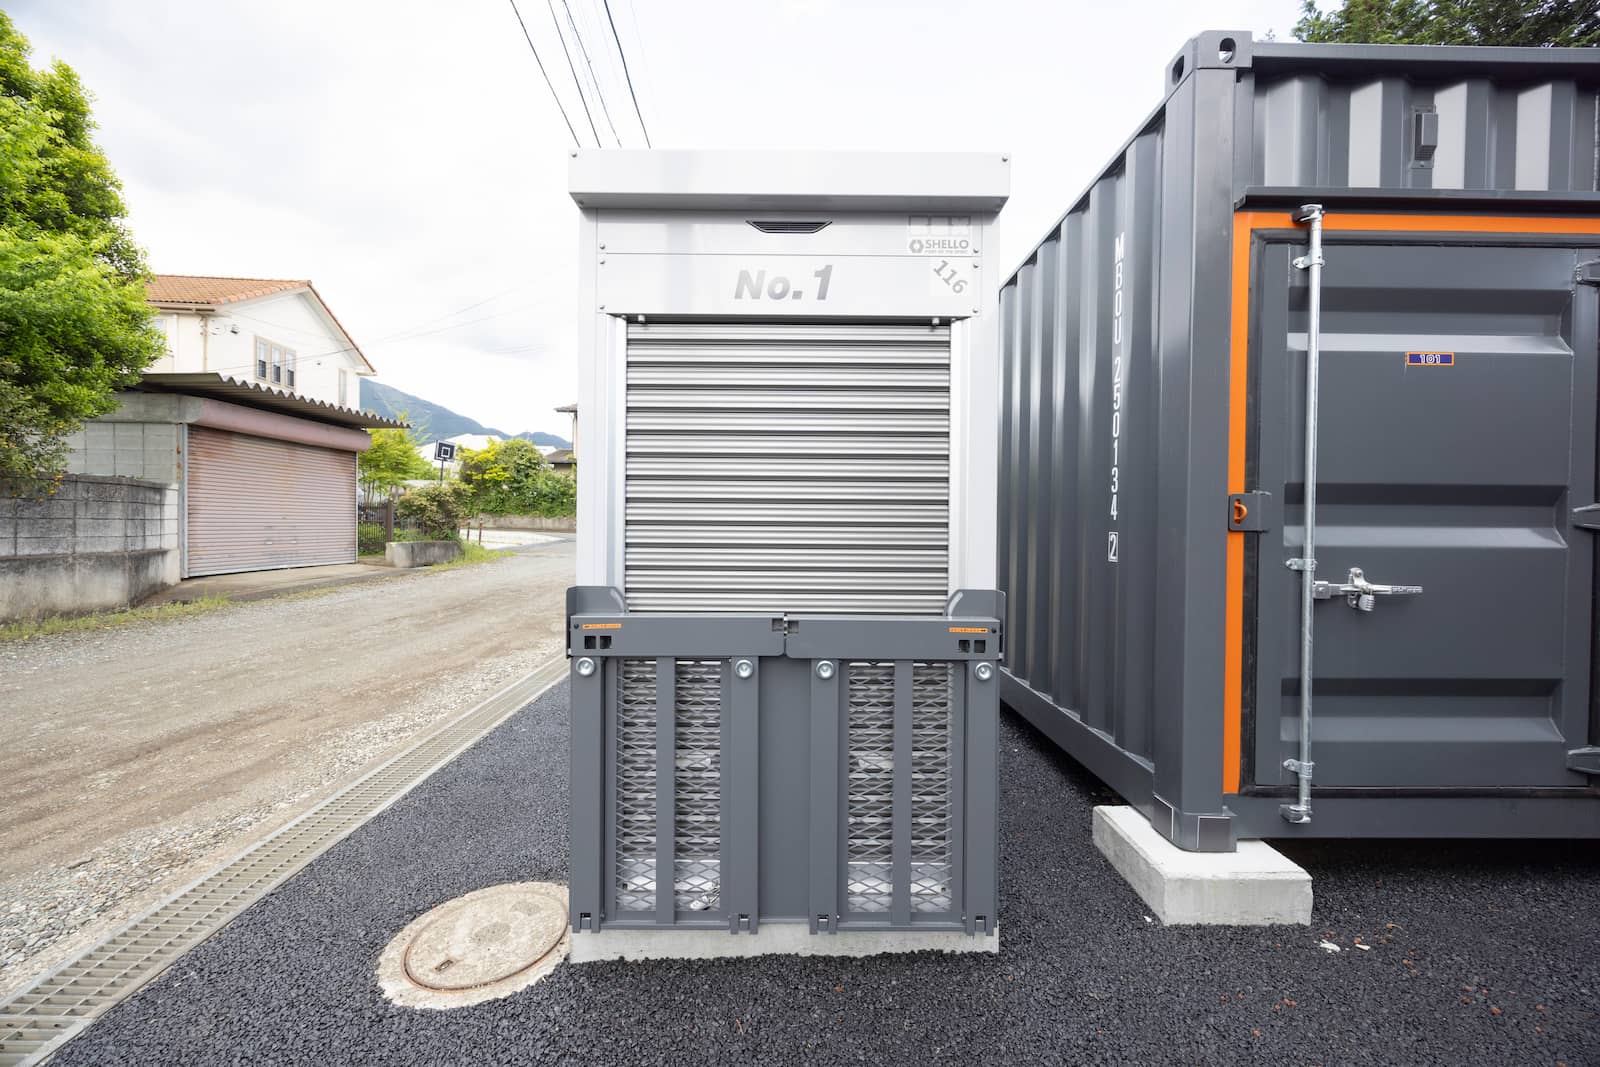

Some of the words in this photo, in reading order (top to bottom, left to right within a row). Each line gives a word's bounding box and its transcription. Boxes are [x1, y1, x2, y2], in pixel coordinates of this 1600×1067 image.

[924, 239, 969, 250] SHELLO
[933, 259, 969, 294] 116
[1114, 231, 1125, 345] MBOU
[1420, 354, 1440, 364] 101
[1110, 356, 1121, 521] 250134
[1109, 533, 1117, 561] 2
